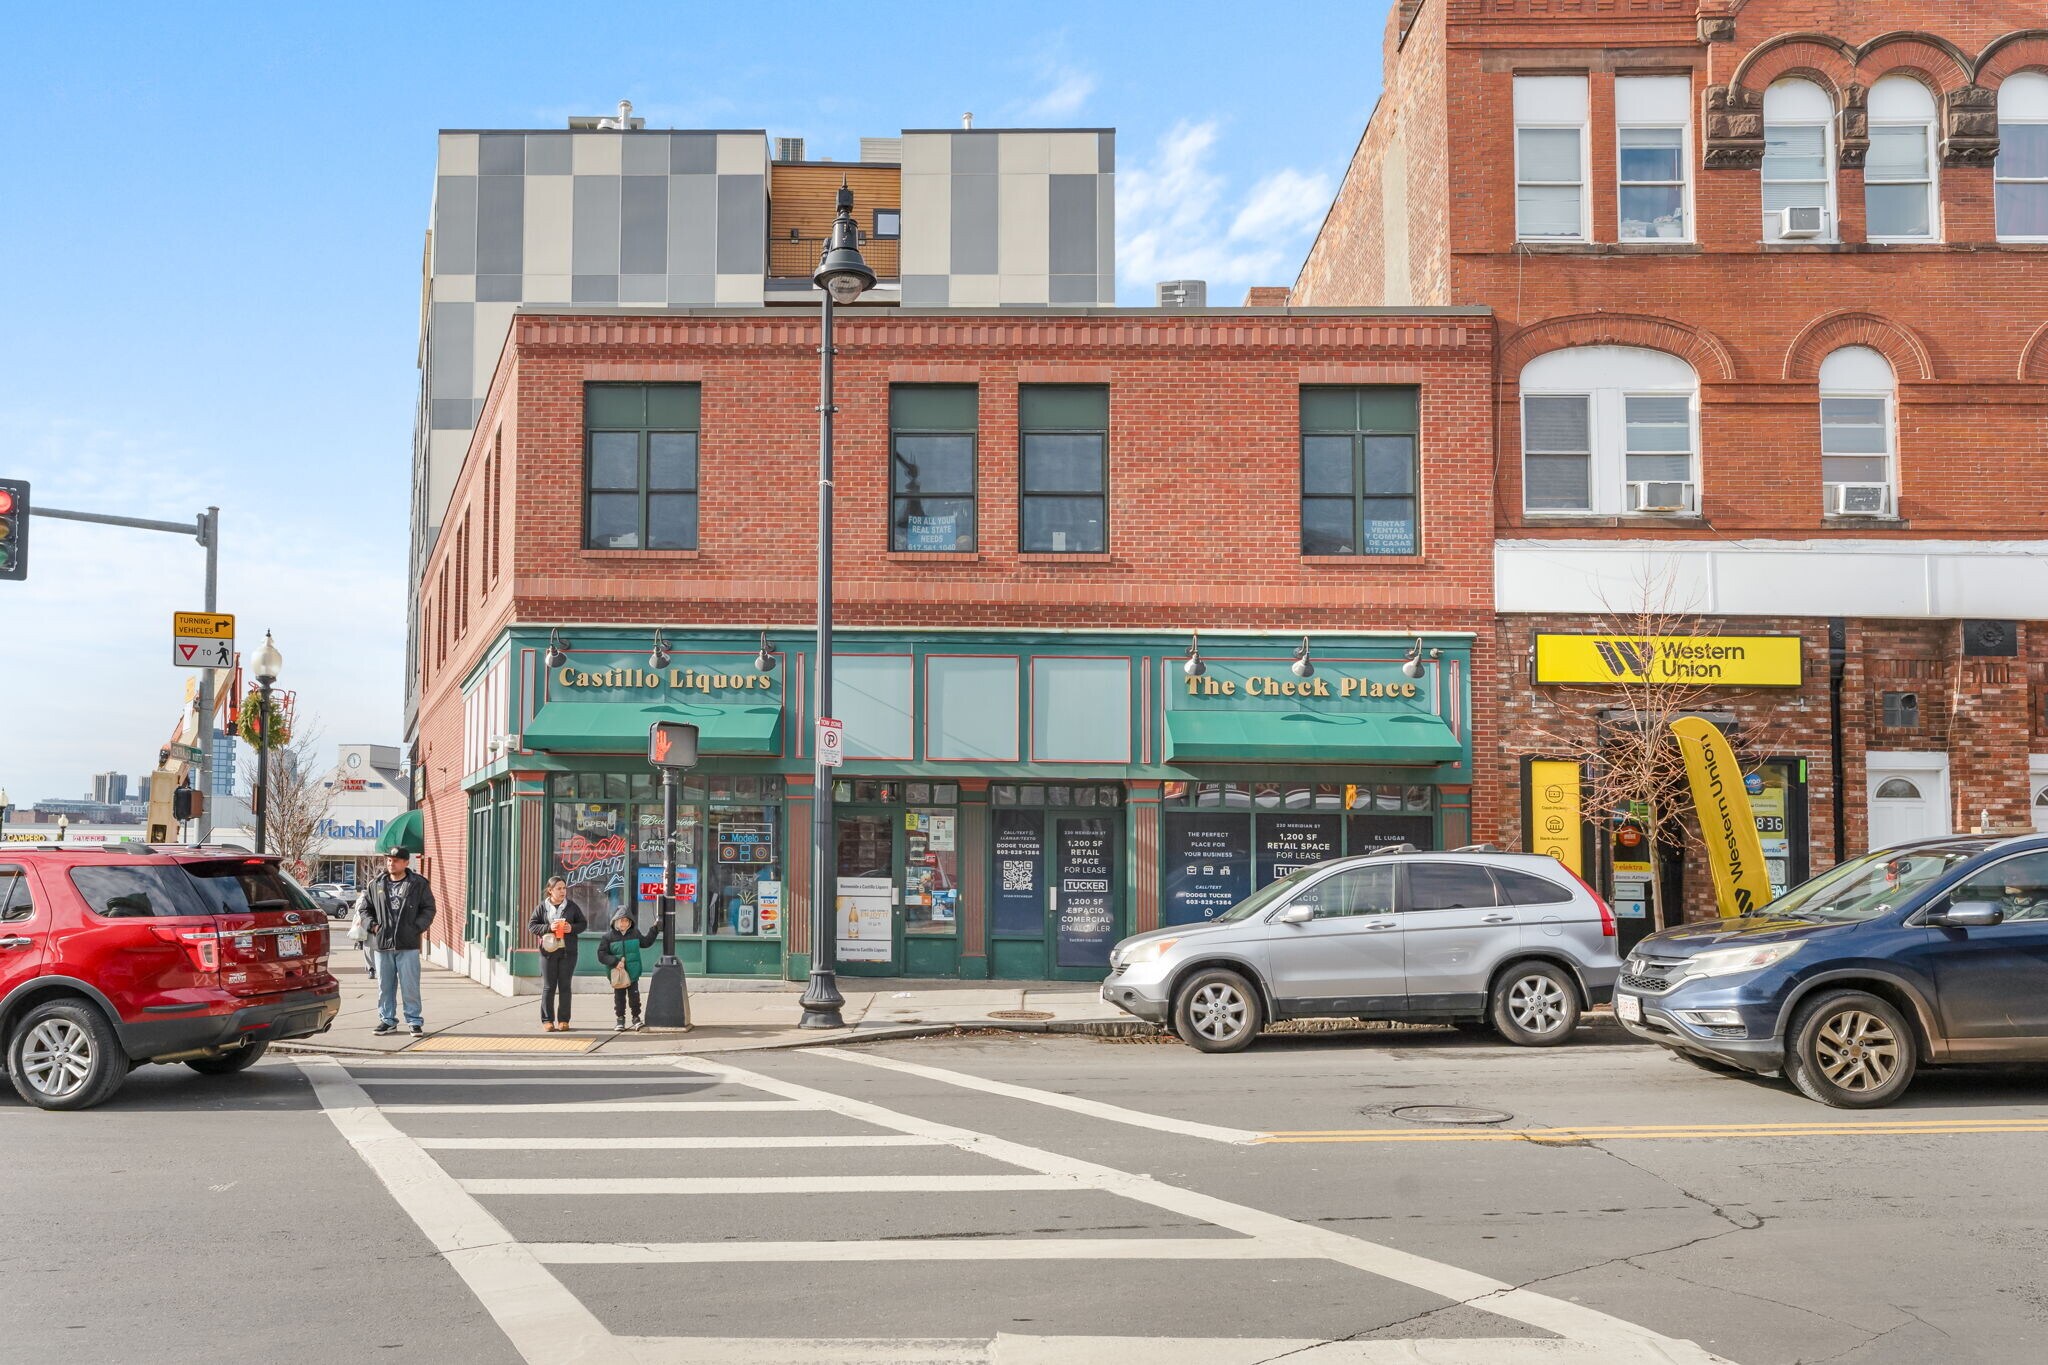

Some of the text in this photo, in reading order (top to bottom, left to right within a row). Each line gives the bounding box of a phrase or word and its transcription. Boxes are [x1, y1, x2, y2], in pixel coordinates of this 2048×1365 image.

[923, 517, 937, 525] ALL
[912, 525, 952, 534] REAL STATE
[920, 535, 944, 543] NEEDS
[179, 617, 211, 625] TURNING
[179, 626, 214, 635] VEHICLES
[1661, 641, 1745, 660] Western
[1662, 659, 1722, 678] Union
[559, 666, 771, 694] Castillo Liquors
[1184, 674, 1417, 698] The Check Place
[1700, 733, 1745, 884] Western Union
[584, 820, 607, 828] OPEN
[319, 819, 384, 839] Marshall
[731, 833, 759, 842] Modelo
[1279, 833, 1318, 841] 1,200 SF
[1267, 842, 1298, 850] RETAIL
[1276, 851, 1321, 860] FOR LEASE
[1071, 857, 1099, 865] SPACE
[566, 855, 626, 888] LIGHT
[1066, 881, 1105, 890] TUCKER
[1061, 915, 1111, 923] COMERCIAL
[1061, 924, 1072, 932] EN
